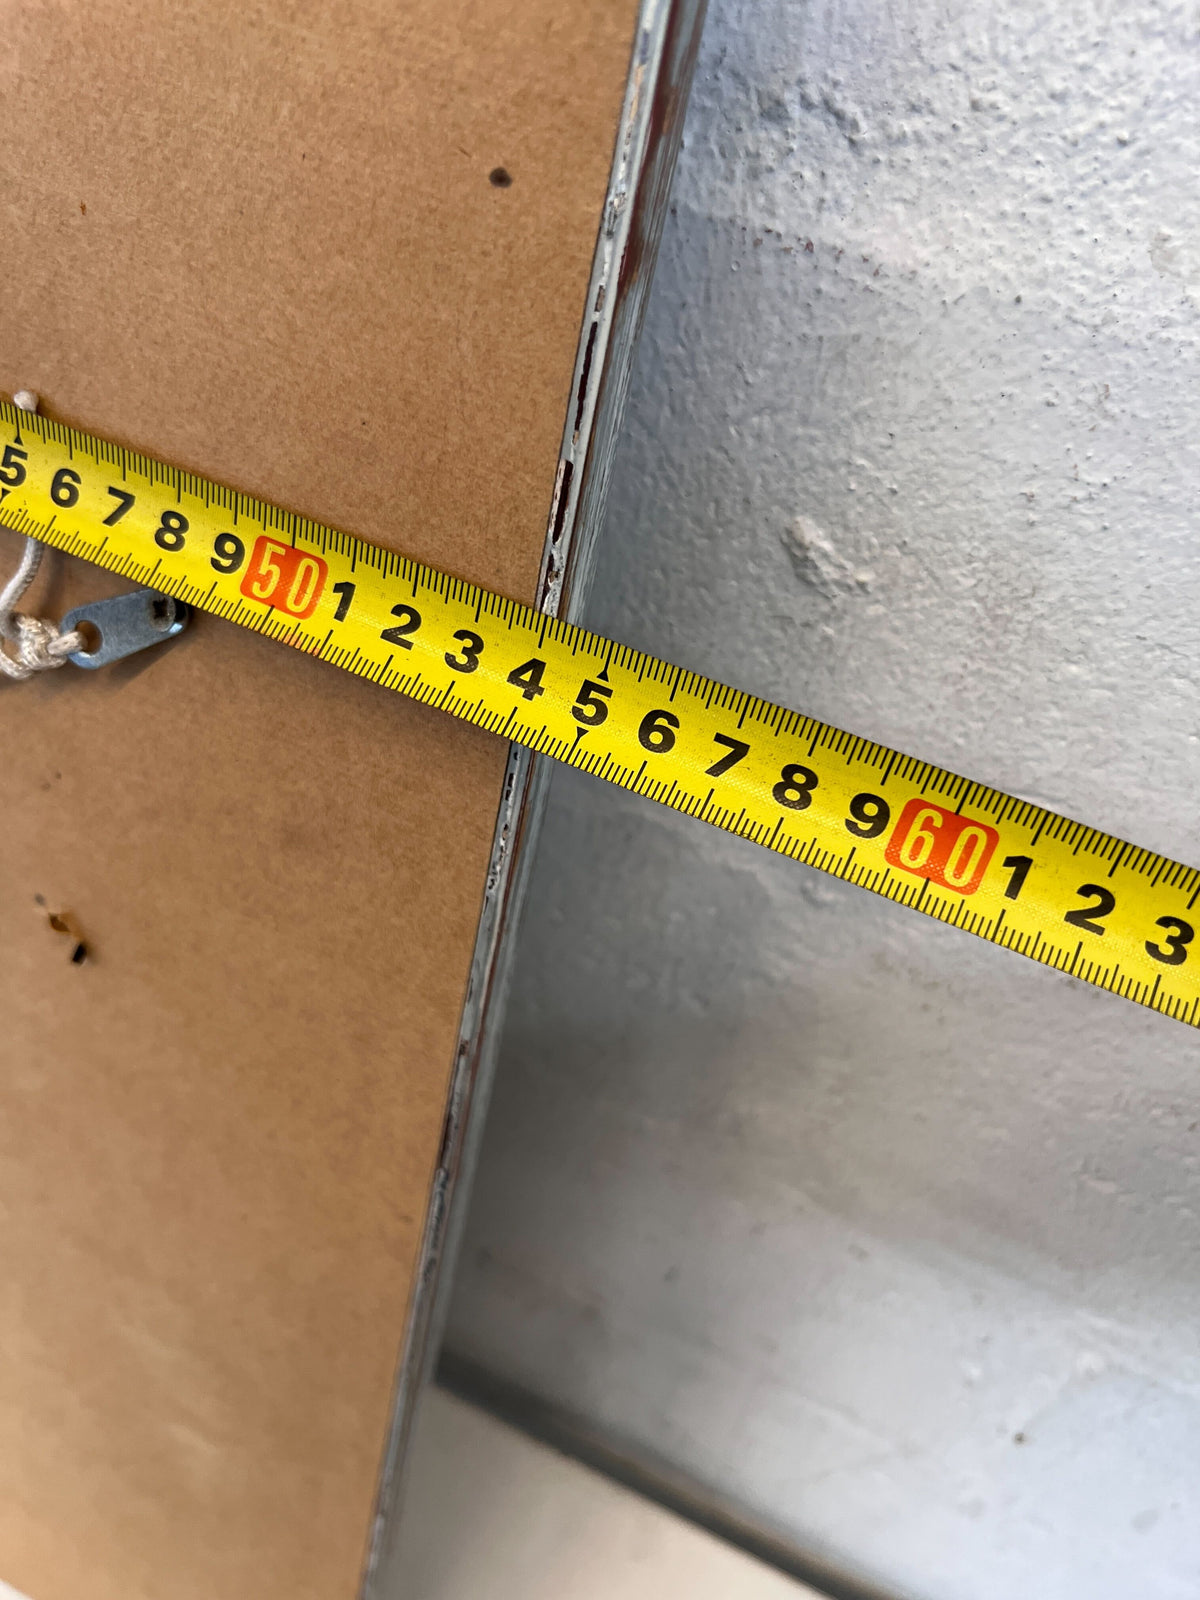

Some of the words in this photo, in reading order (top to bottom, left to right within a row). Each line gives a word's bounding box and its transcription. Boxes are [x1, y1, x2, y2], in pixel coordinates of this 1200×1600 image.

[0, 445, 27, 487] 5
[51, 468, 82, 508] 6
[102, 486, 136, 527] 7
[154, 510, 189, 552] 8
[210, 532, 245, 574] 9
[251, 541, 321, 613] 50
[332, 581, 356, 622] 1
[380, 603, 422, 651] 2
[444, 629, 485, 674] 3
[506, 657, 547, 701] 4
[571, 678, 614, 726] 5
[638, 709, 680, 754] 6
[705, 732, 751, 778] 7
[772, 763, 819, 811] 8
[844, 792, 891, 839] 9
[899, 808, 989, 888] 60
[1002, 855, 1034, 901] 1
[1064, 883, 1116, 936] 2
[1145, 915, 1195, 966] 3
